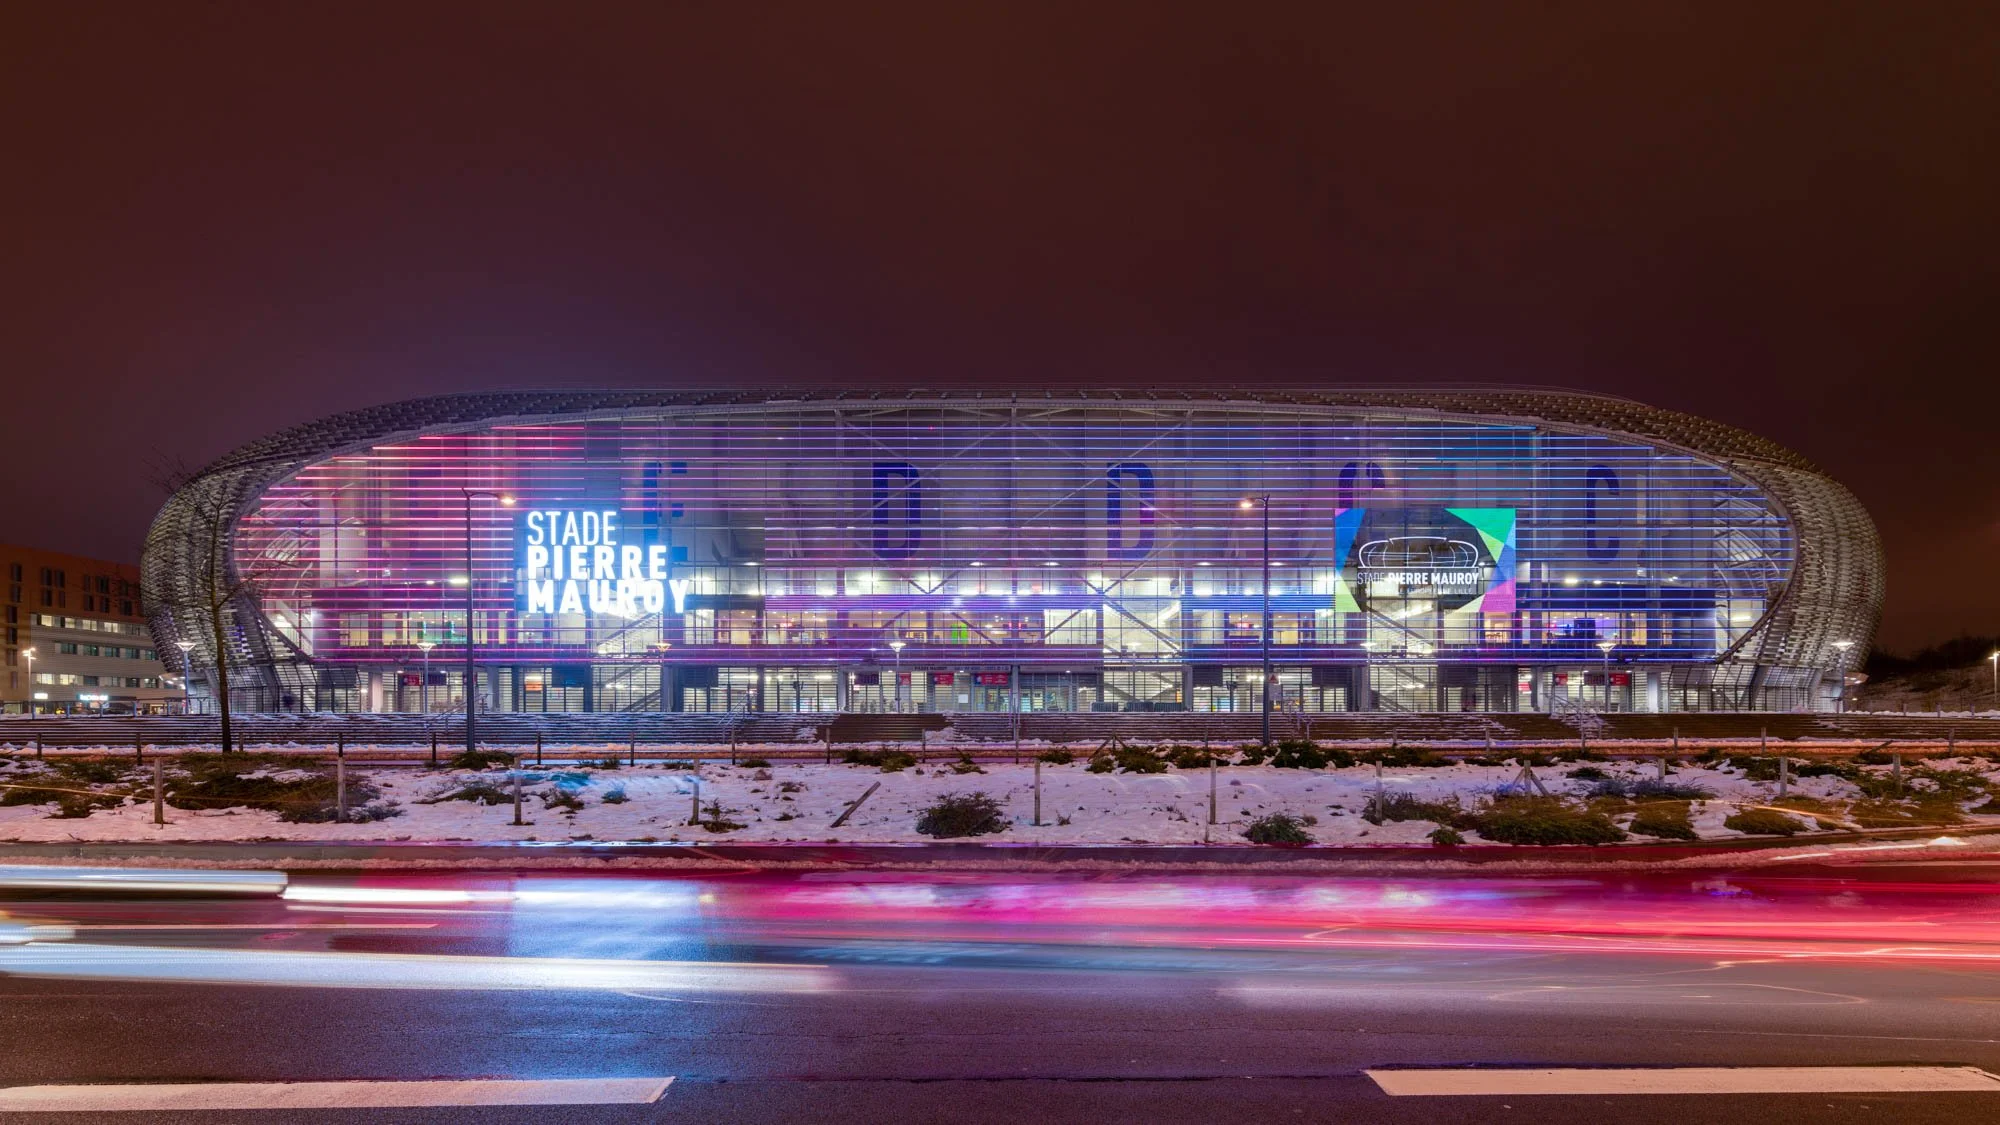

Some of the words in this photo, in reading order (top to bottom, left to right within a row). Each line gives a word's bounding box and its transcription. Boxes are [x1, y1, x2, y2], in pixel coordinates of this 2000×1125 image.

[872, 462, 921, 560] D
[1107, 463, 1154, 558] D
[1586, 465, 1620, 562] C
[527, 511, 617, 546] STADE
[527, 545, 667, 580] PIERRE
[1387, 572, 1428, 585] PIERRE
[1431, 572, 1479, 585] MAUROY
[527, 580, 689, 614] MAUROY
